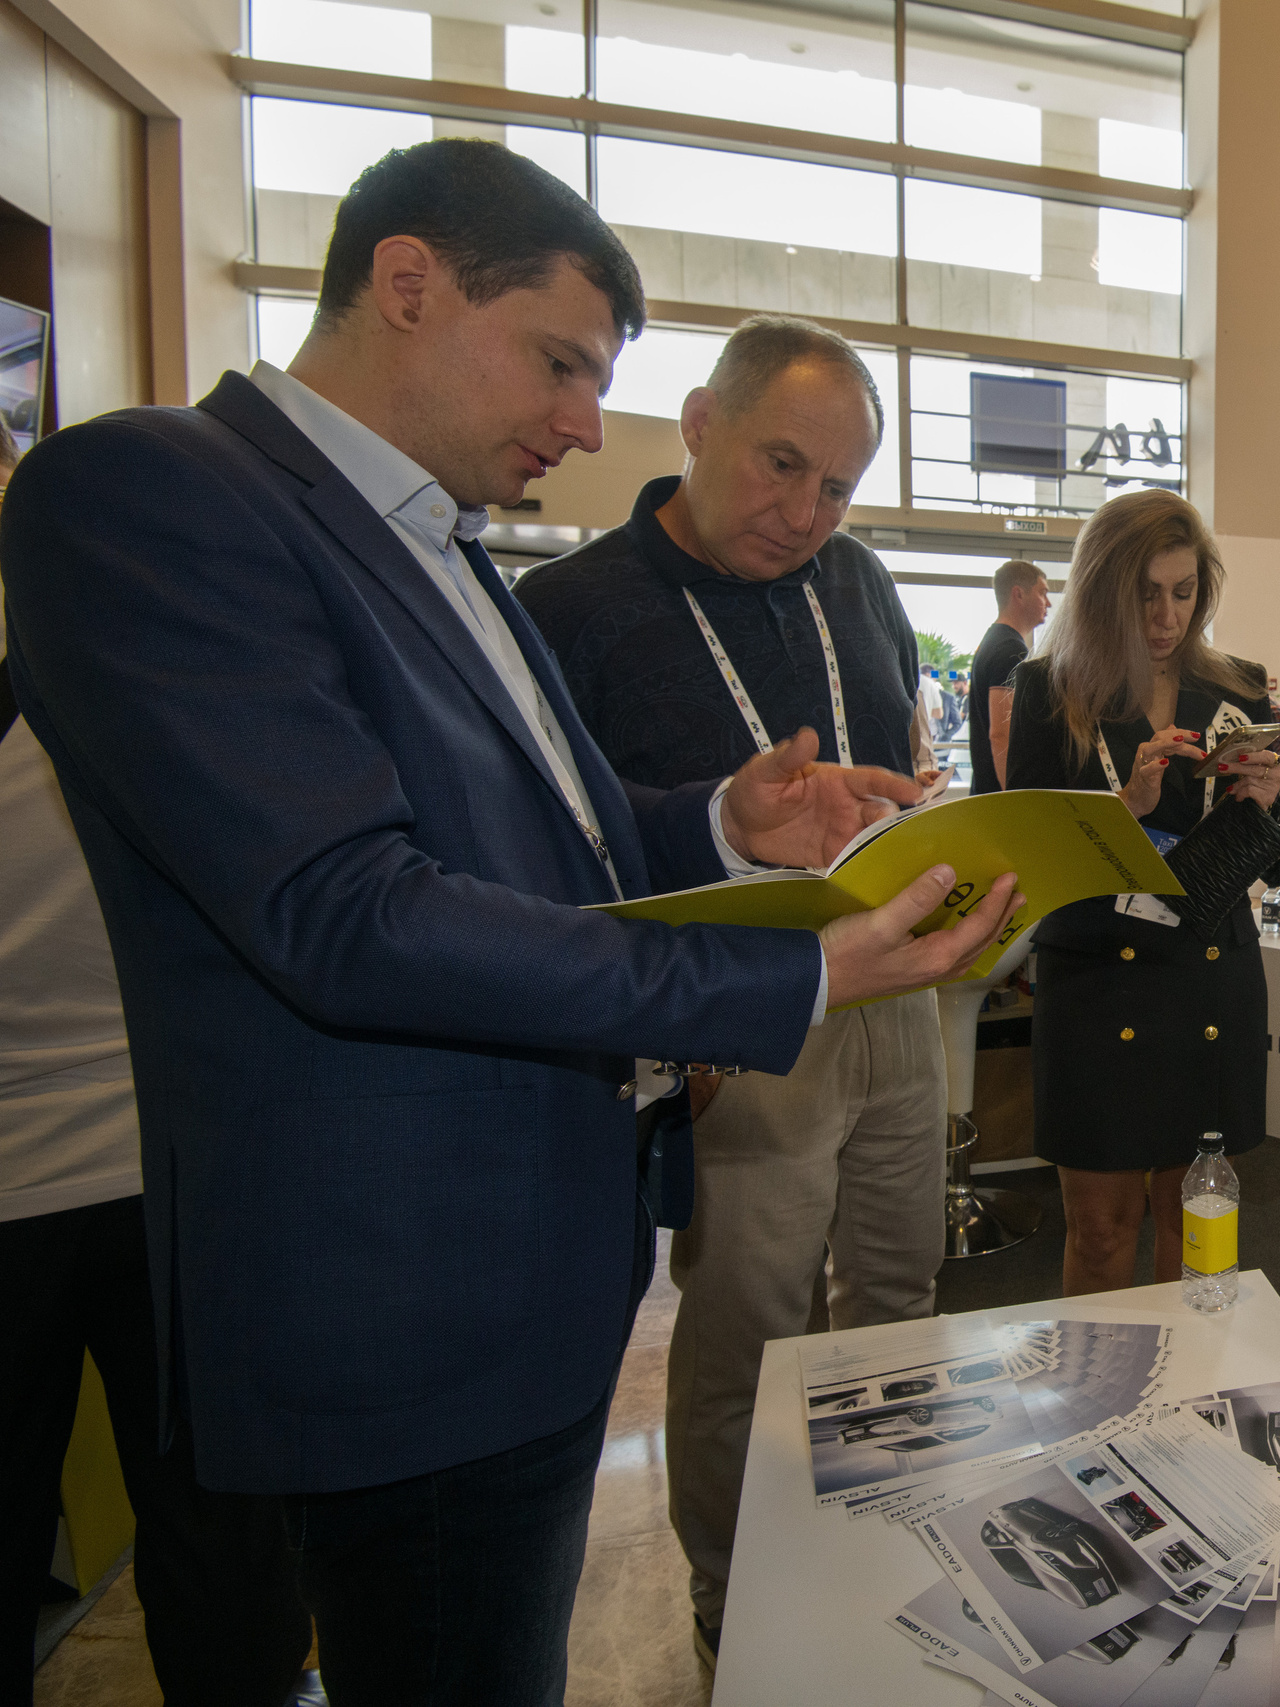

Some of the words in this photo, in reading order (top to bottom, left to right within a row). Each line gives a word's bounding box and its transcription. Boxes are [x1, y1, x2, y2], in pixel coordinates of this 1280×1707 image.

[1007, 520, 1043, 532] ВЫХОД
[1159, 838, 1173, 848] Taxi
[820, 1486, 881, 1505] ALSVIN
[852, 1493, 912, 1516] ALSVIN
[889, 1493, 947, 1519] ALSVIN
[910, 1497, 966, 1525] ALSVIN
[923, 1524, 941, 1543] PLUS
[936, 1541, 963, 1574] EADO
[898, 1616, 919, 1632] PLUS
[990, 1616, 1005, 1631] AUTO
[920, 1631, 960, 1657] EADO
[1001, 1630, 1024, 1657] CHANGAN
[1014, 1692, 1034, 1707] AUTO
